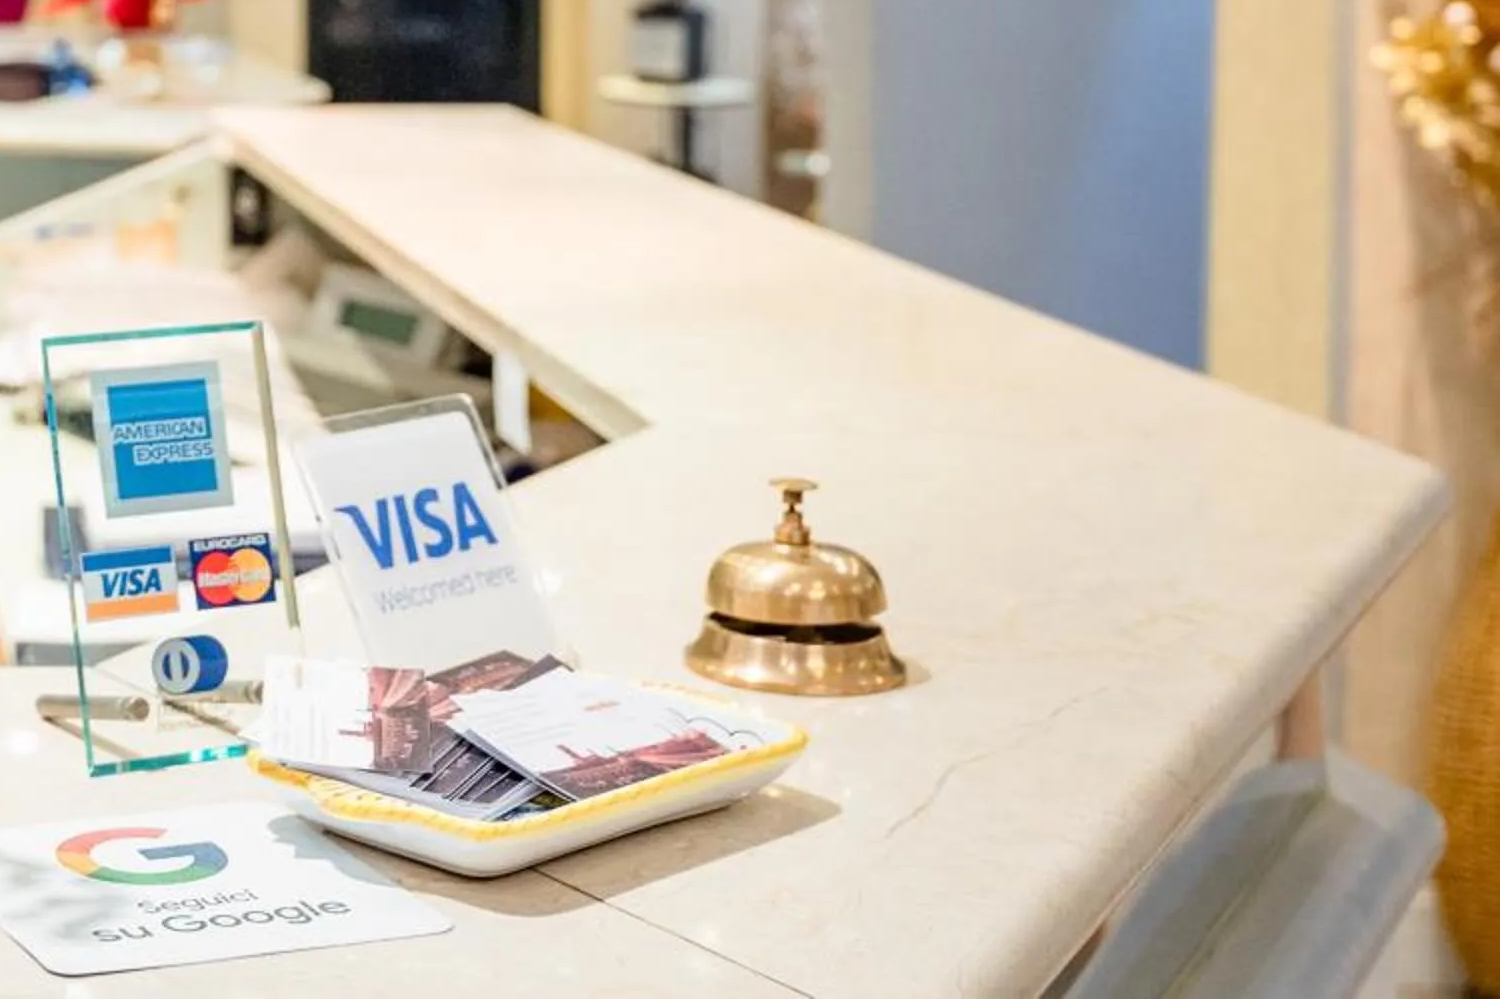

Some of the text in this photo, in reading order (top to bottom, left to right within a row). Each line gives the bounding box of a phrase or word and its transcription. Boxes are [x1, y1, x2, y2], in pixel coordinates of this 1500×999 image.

[113, 418, 204, 442] AMERICAN
[135, 441, 213, 463] EXPRESS
[333, 481, 499, 570] VISA
[194, 533, 268, 552] EUROCARD
[100, 568, 162, 598] VISA
[373, 565, 518, 614] Welcomed here
[136, 888, 260, 914] Seguici
[91, 899, 351, 942] su Google
